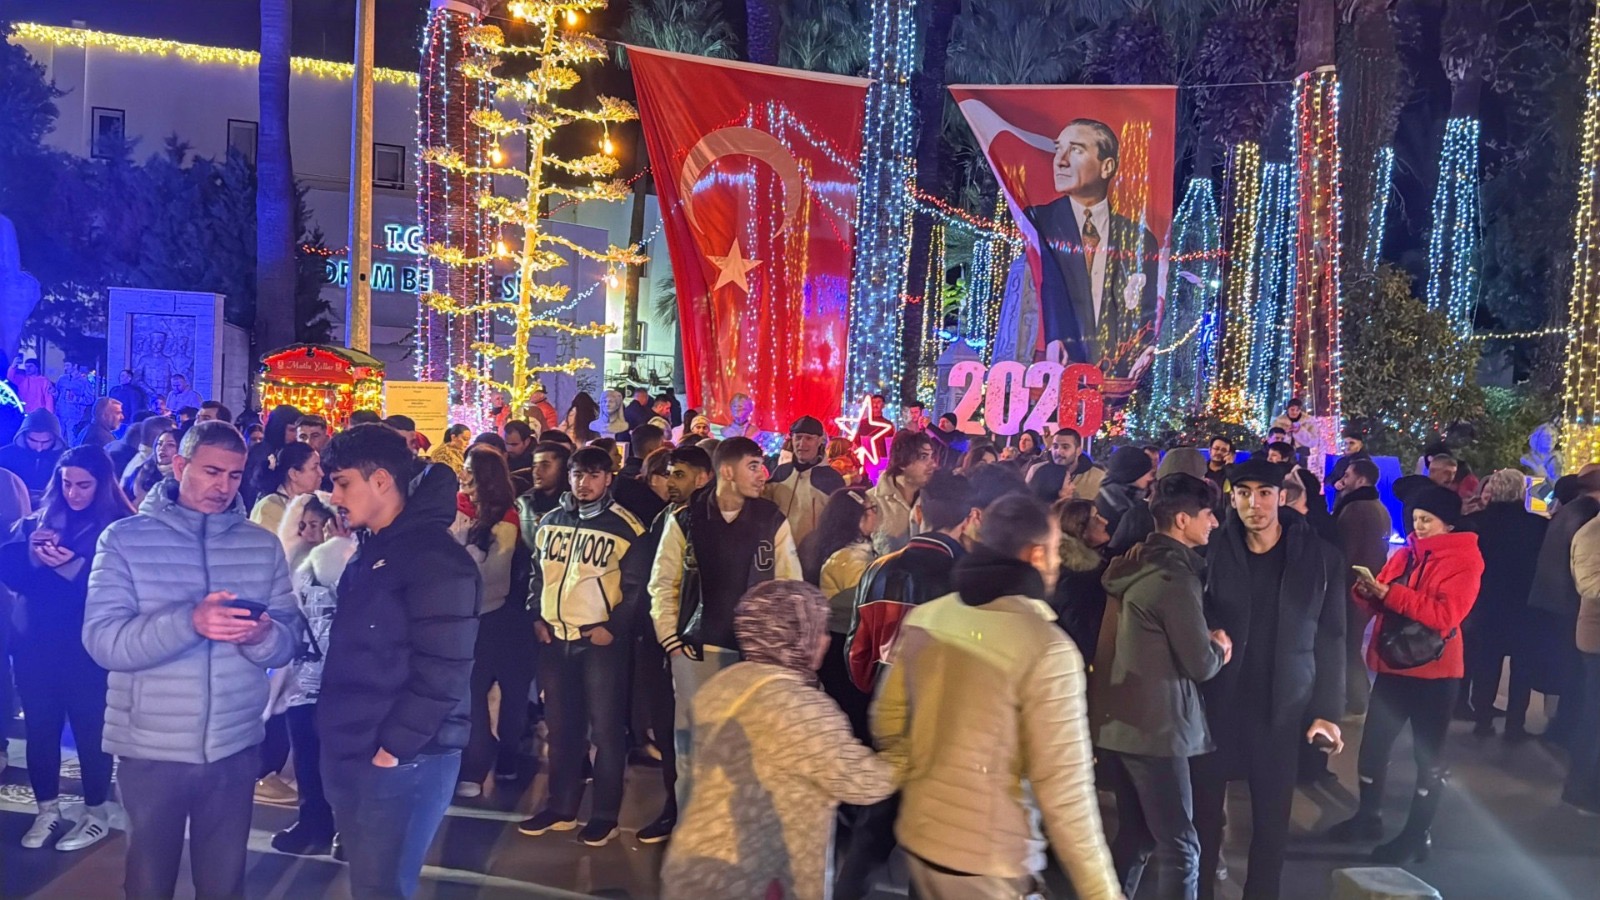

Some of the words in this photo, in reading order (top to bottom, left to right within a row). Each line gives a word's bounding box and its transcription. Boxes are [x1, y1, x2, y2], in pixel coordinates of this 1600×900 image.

[385, 224, 427, 255] T.C
[948, 361, 1104, 437] 2026
[541, 530, 571, 563] ACE
[573, 533, 615, 567] MOOD
[754, 540, 773, 571] C
